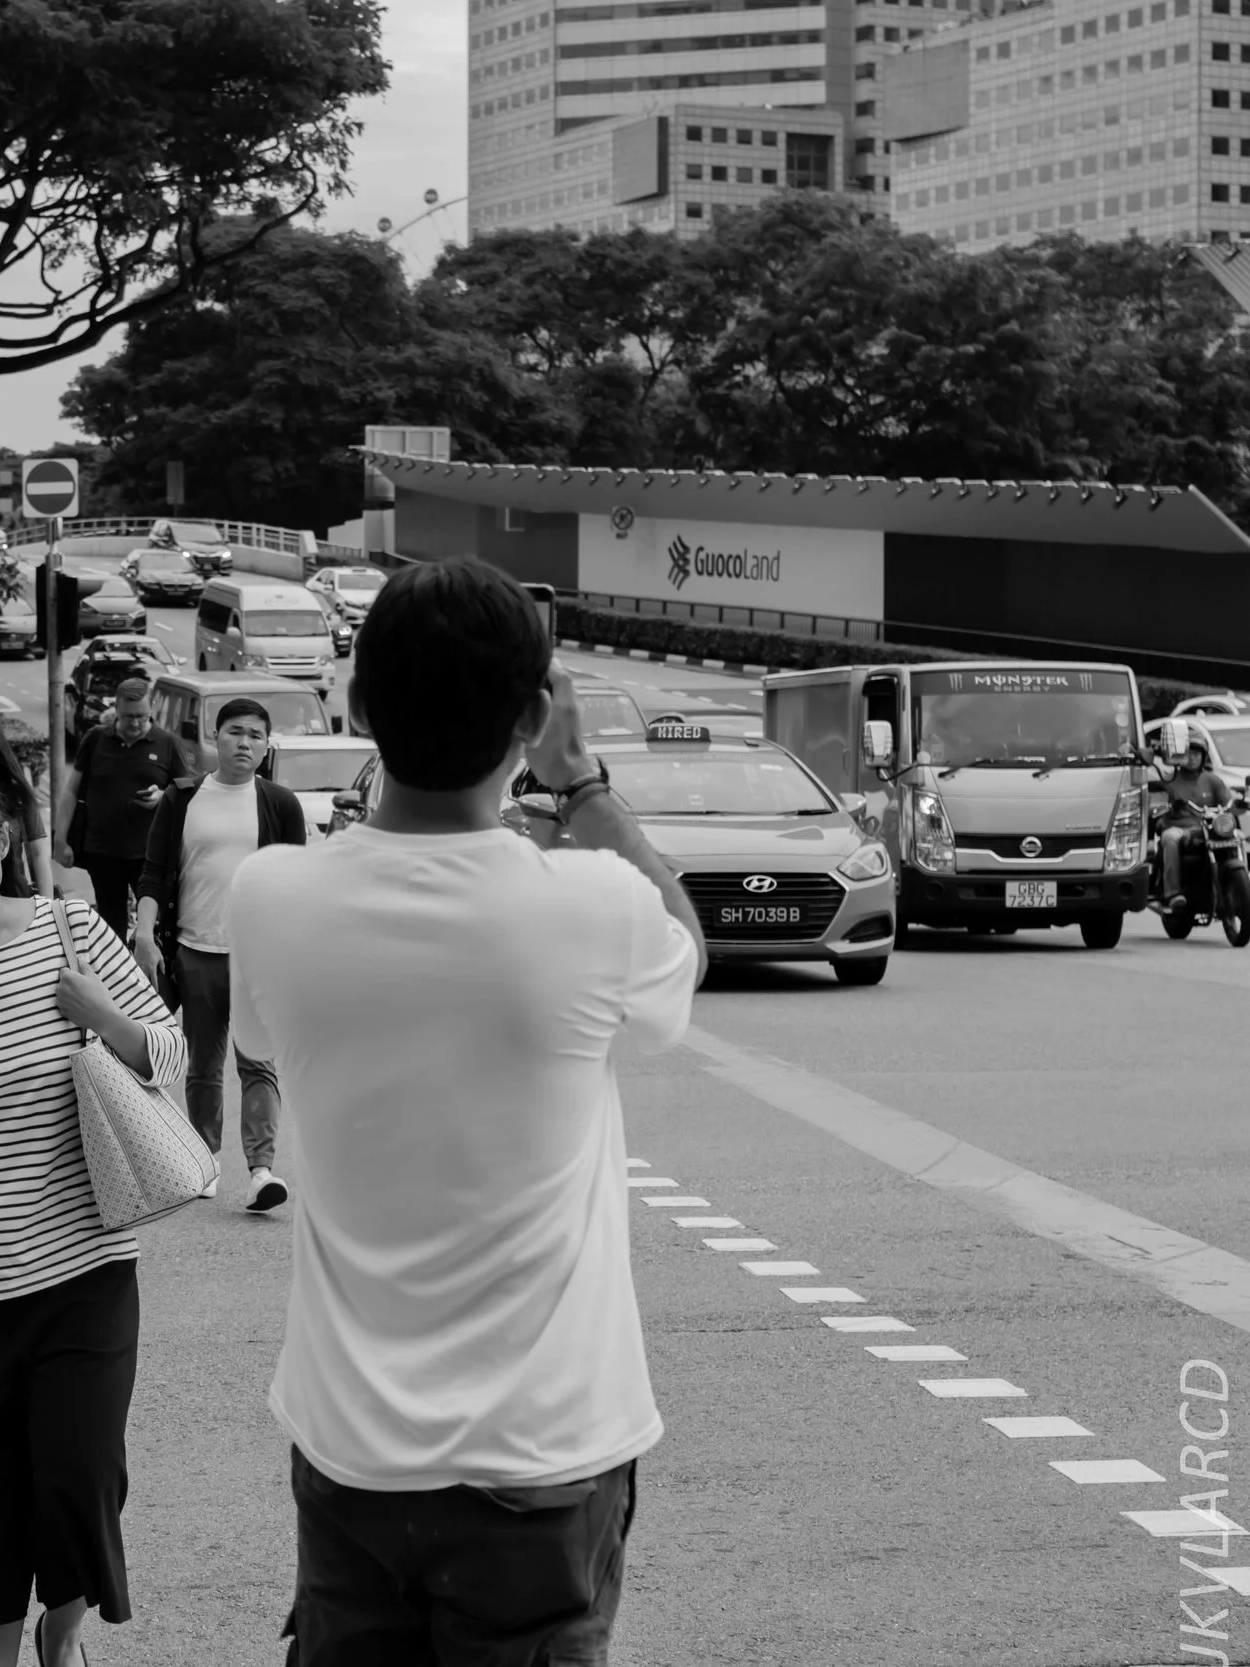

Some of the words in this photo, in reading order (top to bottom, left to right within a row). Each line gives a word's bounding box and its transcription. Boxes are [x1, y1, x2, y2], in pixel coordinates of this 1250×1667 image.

[695, 546, 781, 582] GuocoLand
[974, 674, 1069, 686] MONSTER
[657, 726, 701, 739] HIRED
